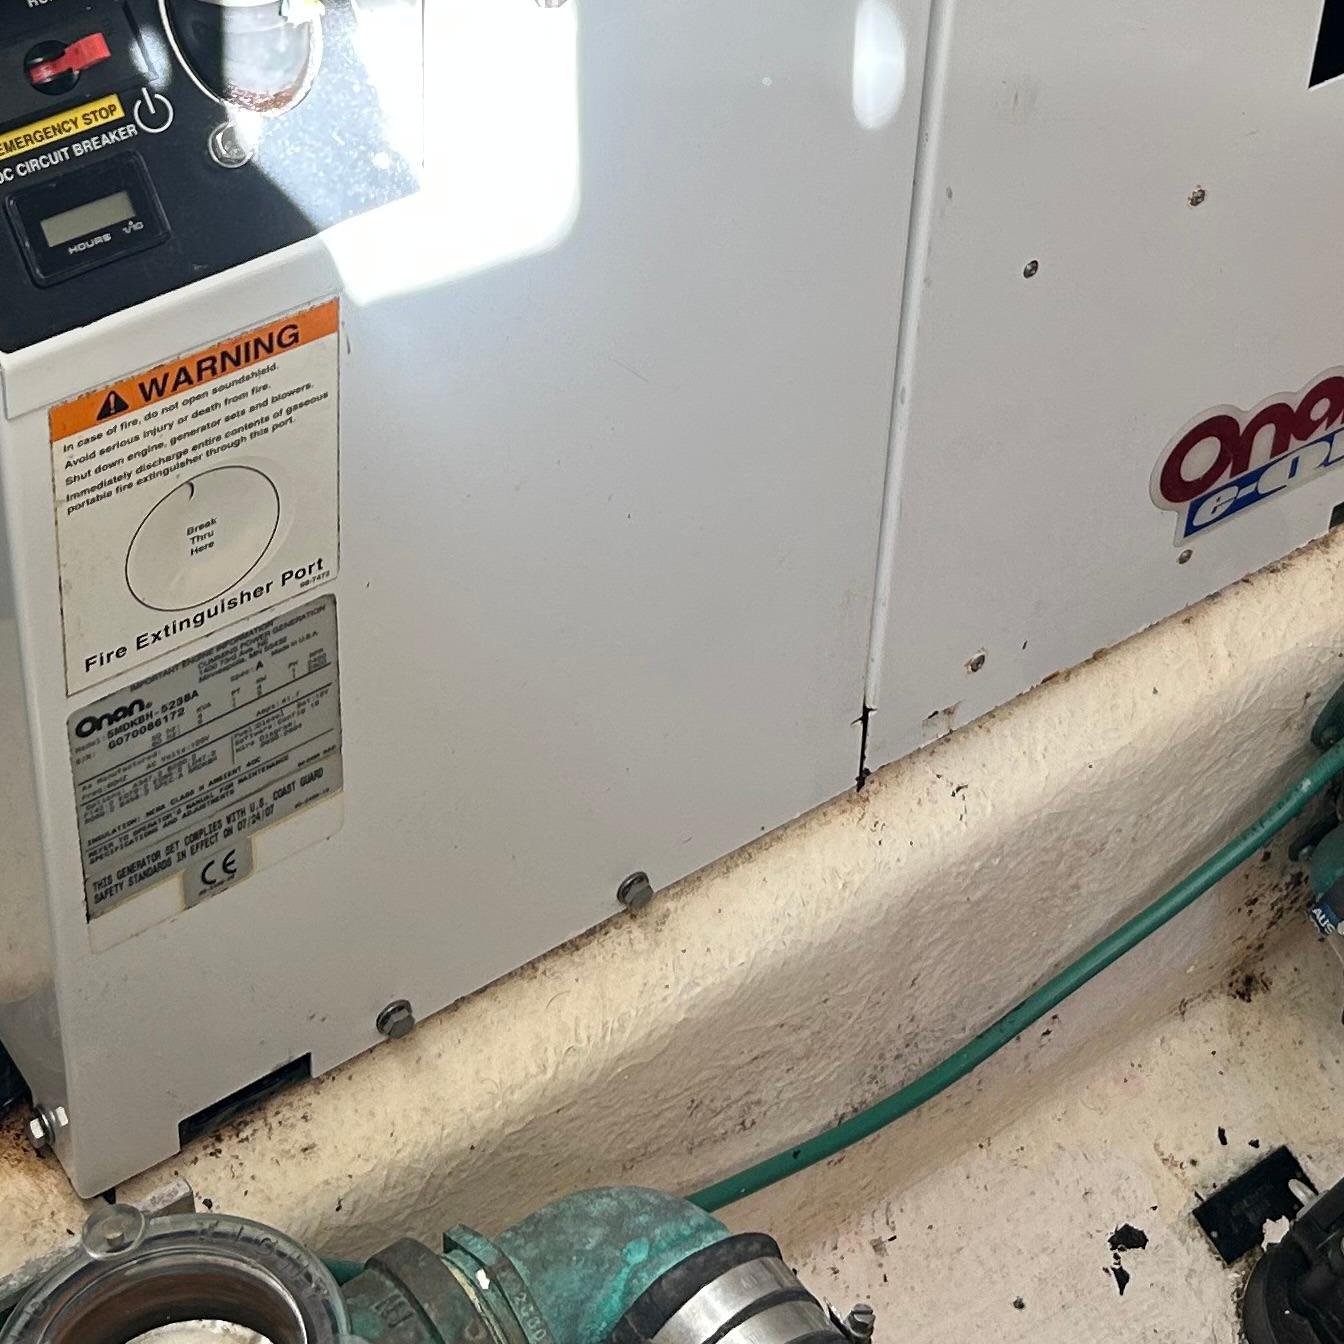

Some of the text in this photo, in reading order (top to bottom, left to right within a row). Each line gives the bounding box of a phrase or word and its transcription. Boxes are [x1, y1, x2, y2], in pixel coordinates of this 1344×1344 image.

[81, 104, 116, 125] STOP
[16, 147, 69, 175] CIRCUIT
[72, 124, 137, 155] BREAKER
[68, 233, 111, 253] HOURS
[139, 324, 298, 400] WARNING
[63, 443, 73, 452] In
[77, 432, 102, 447] case
[106, 424, 117, 435] of
[120, 418, 141, 430] fire,
[143, 410, 158, 421] do
[161, 401, 178, 414] not
[181, 391, 208, 405] open
[64, 383, 270, 469] Avoid serious injury or death from fire.
[65, 383, 311, 485] Shut down engine, generator sets and blowers.
[66, 392, 328, 501] Immediately discharge entire contents of gaseous
[67, 416, 293, 515] portable fire extinguisher through this port.
[186, 518, 216, 535] Break
[190, 530, 213, 544] Thru
[190, 541, 214, 555] Here
[85, 558, 322, 672] Fire Extinguisher Port
[255, 660, 263, 670] A
[75, 699, 144, 737] Onan
[92, 874, 112, 890] THIS
[116, 850, 160, 879] GENERATOR
[165, 840, 179, 856] SET
[184, 819, 222, 845] COMPLIES
[225, 807, 245, 824] WITH
[272, 781, 295, 800] COAST
[299, 767, 323, 786] GUARD
[94, 881, 123, 904] SAFETY
[128, 857, 171, 886] STANDARDS
[176, 850, 186, 862] IN
[190, 832, 217, 855] EFFECT
[223, 826, 232, 838] ON
[201, 849, 237, 884] CE
